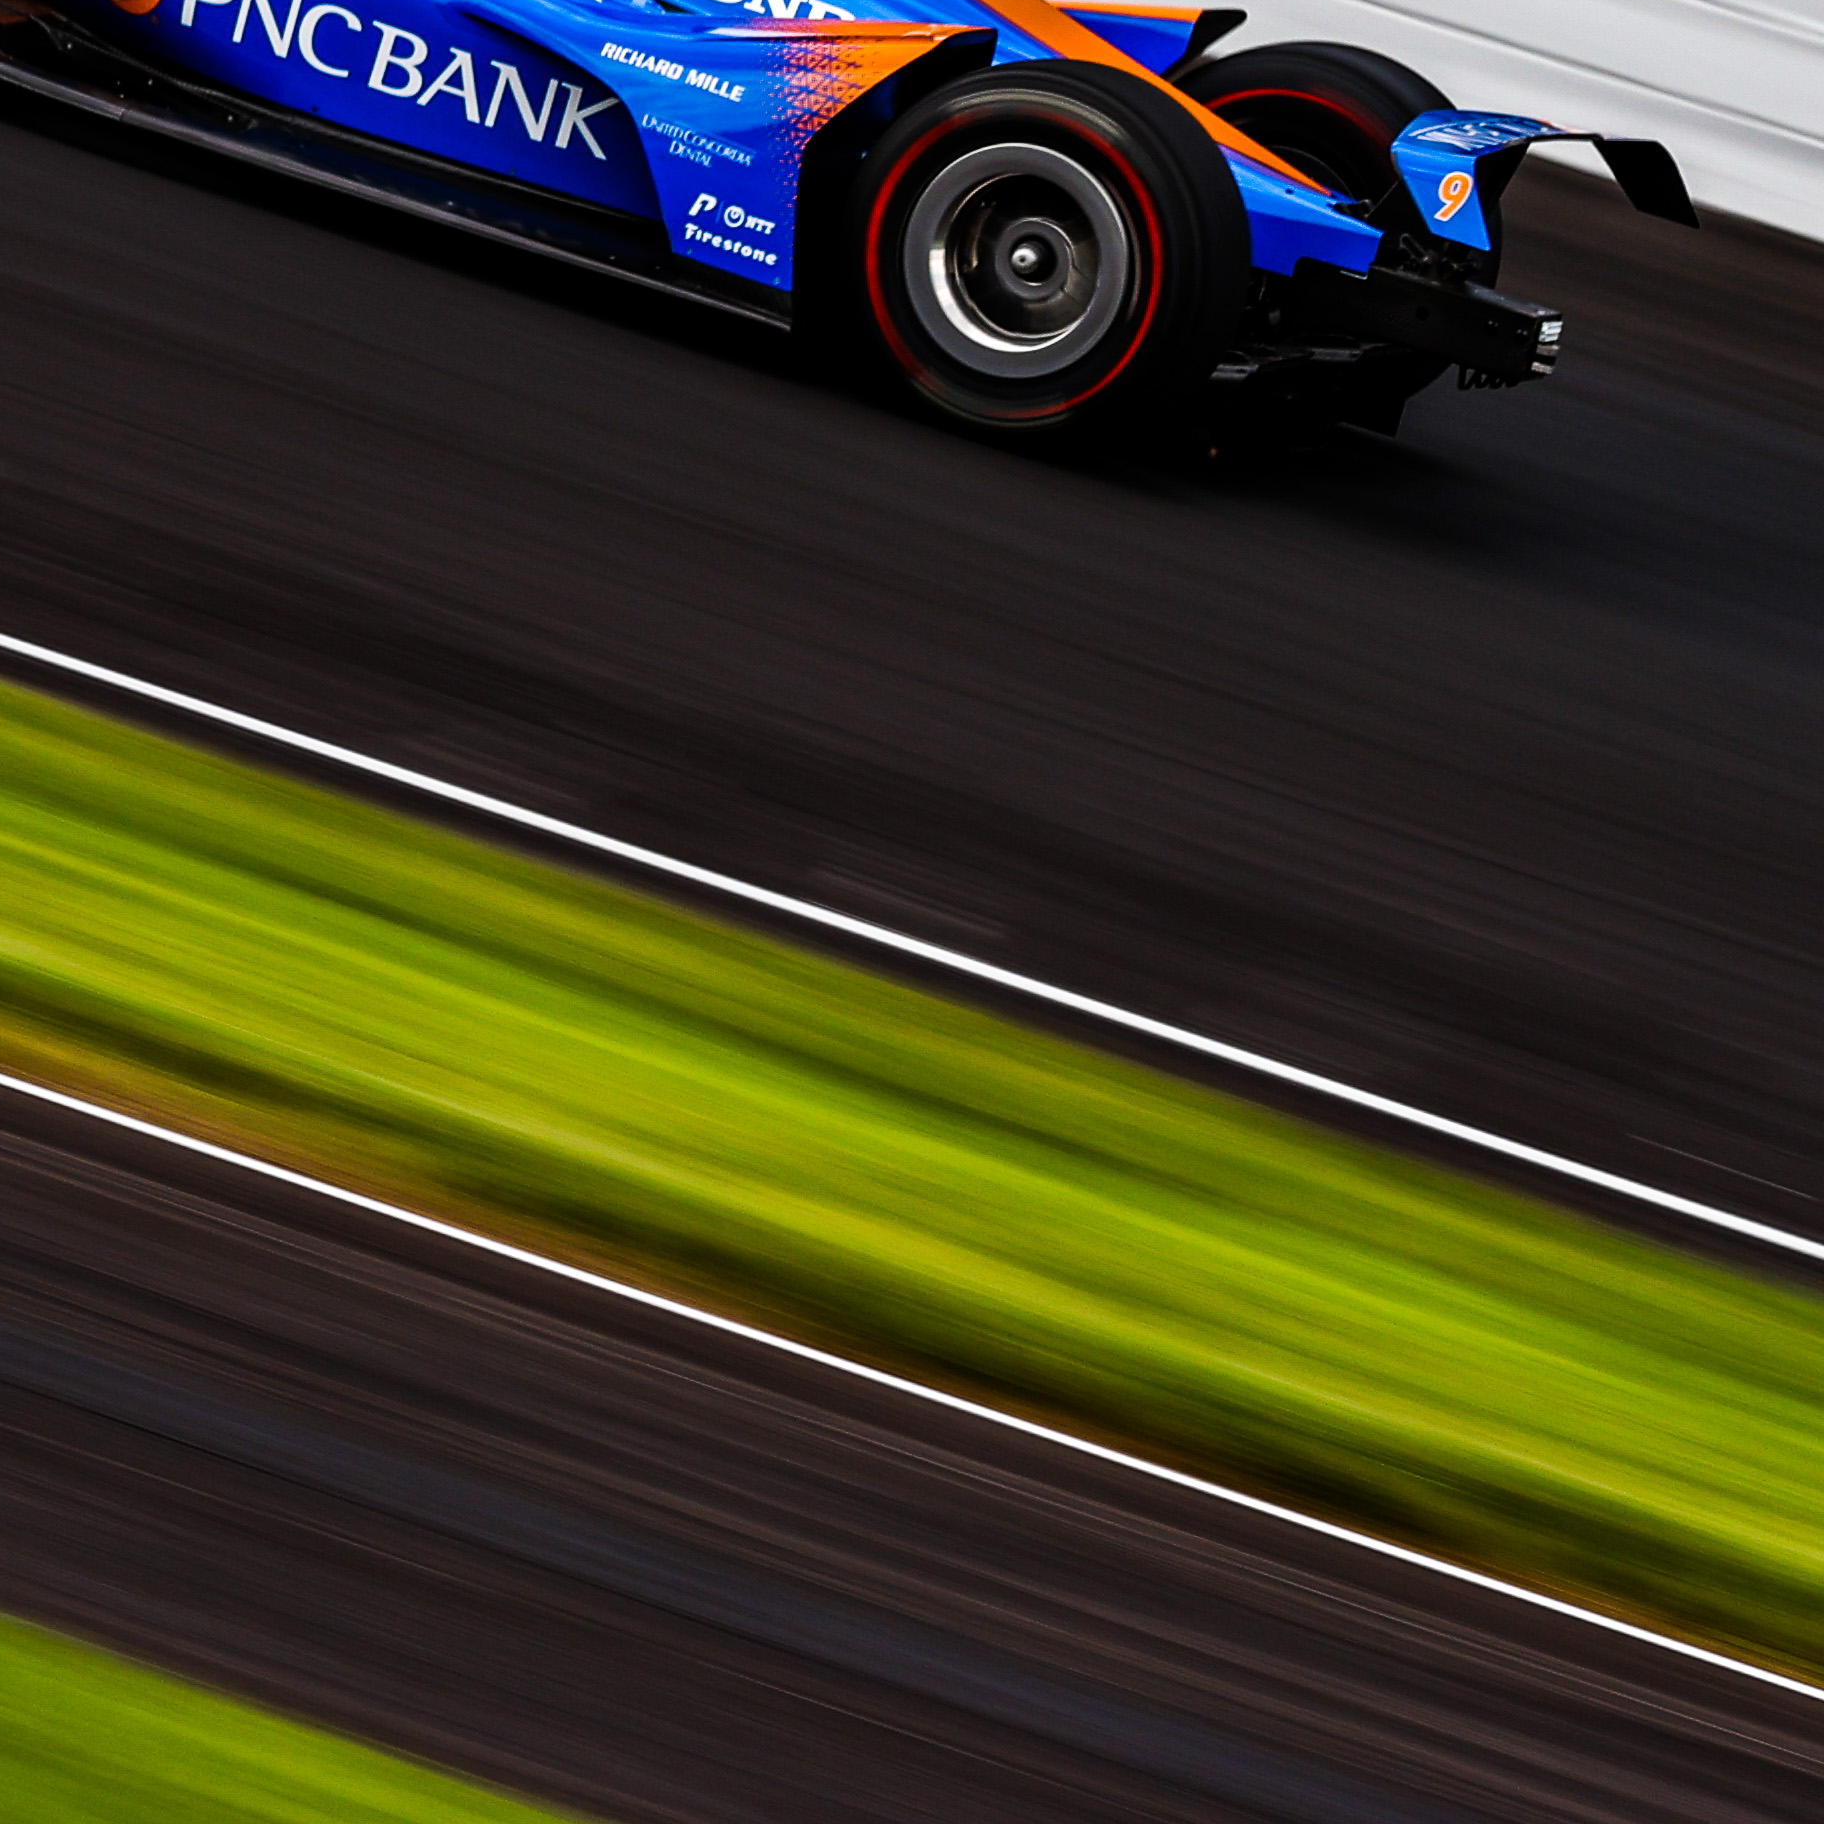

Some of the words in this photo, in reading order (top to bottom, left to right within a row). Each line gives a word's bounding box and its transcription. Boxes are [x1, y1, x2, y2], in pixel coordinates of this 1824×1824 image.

[367, 19, 621, 161] BANK
[600, 42, 684, 81] RICHARD
[684, 68, 746, 103] MILLE
[1433, 171, 1474, 222] 9
[684, 222, 778, 266] Firestone
[744, 214, 776, 235] NTT
